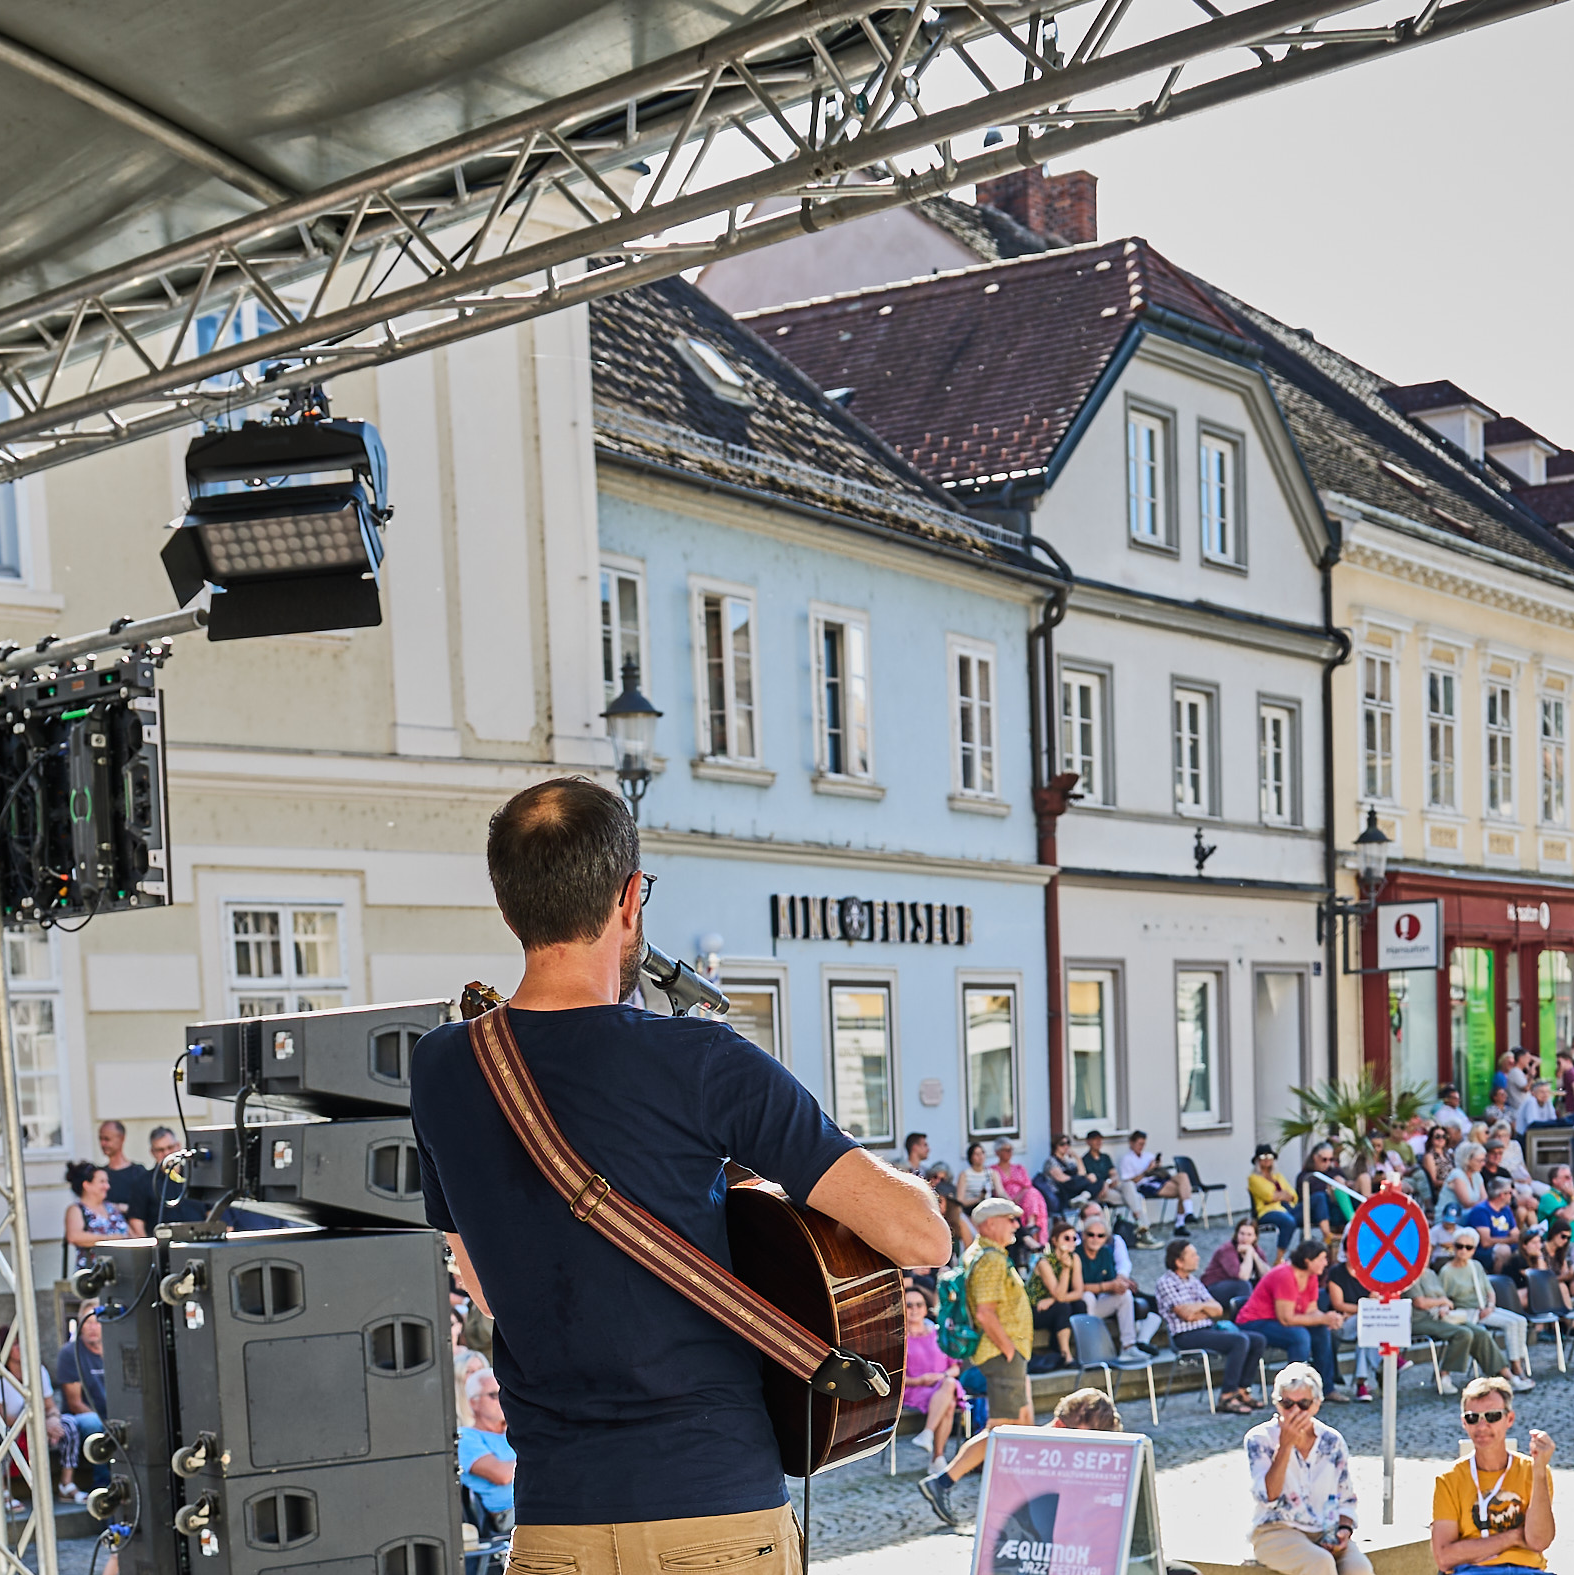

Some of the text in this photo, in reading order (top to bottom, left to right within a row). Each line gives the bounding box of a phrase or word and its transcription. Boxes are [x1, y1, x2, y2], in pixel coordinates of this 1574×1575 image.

[771, 893, 973, 945] KING FRISEUR
[999, 1446, 1020, 1466] 17.
[1038, 1448, 1066, 1468] 20.
[1072, 1450, 1128, 1472] SEPT.
[1018, 1561, 1050, 1575] JAZZ
